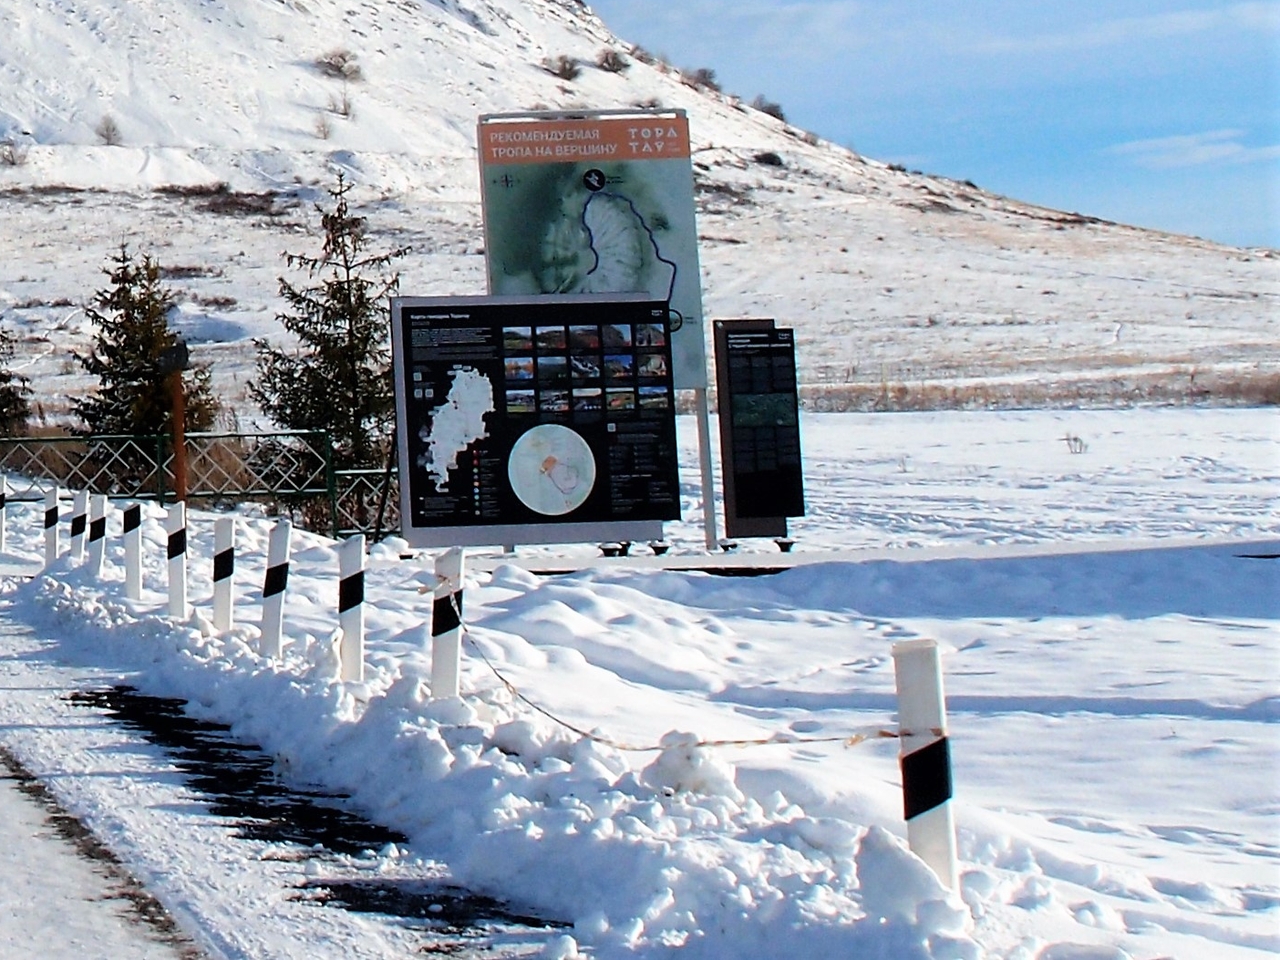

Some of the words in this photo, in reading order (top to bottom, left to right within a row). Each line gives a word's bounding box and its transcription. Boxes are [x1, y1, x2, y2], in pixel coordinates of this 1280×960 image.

[490, 129, 600, 142] РЕКОМЕНДУЕМАЯ
[492, 146, 533, 158] ТРОПА
[535, 146, 552, 157] НА
[555, 144, 618, 156] ВЕРШИНУ
